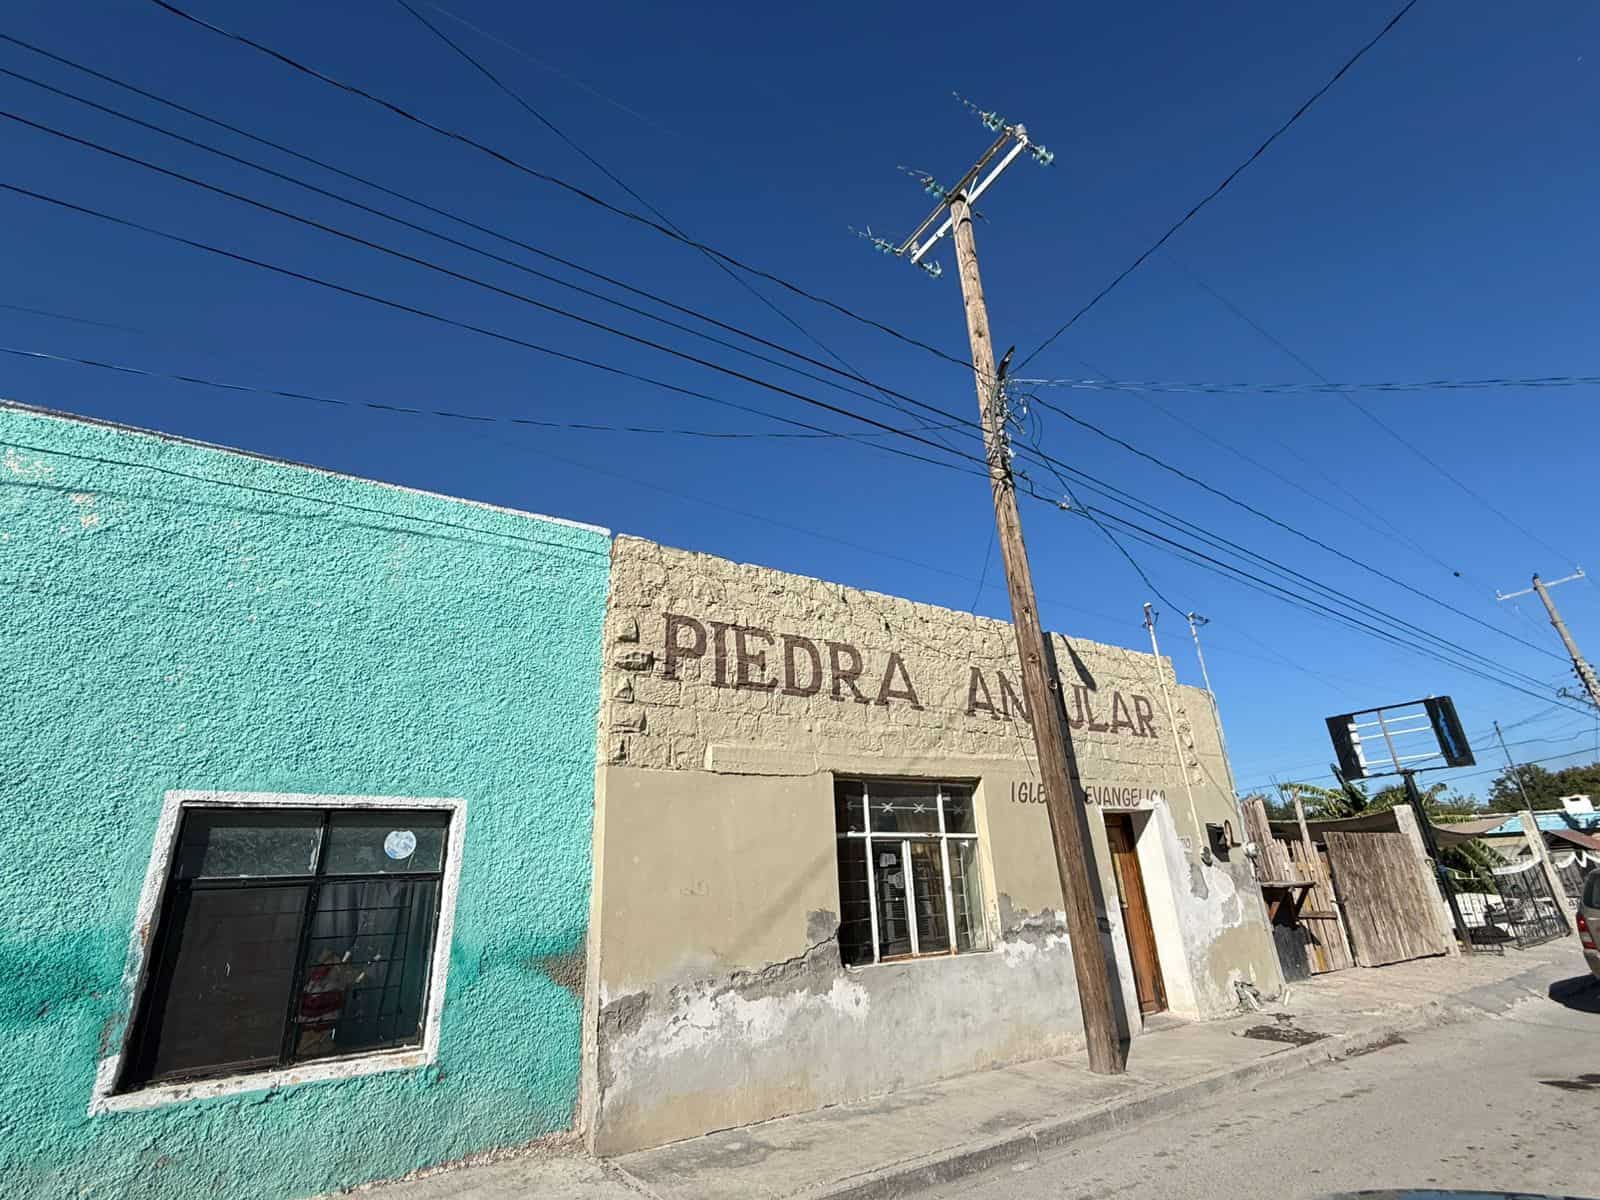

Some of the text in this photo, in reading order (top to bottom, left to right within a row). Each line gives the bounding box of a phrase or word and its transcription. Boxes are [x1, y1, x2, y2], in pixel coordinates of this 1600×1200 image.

[662, 612, 1159, 739] PIEDRA ANULAR
[1011, 781, 1047, 804] IGLE
